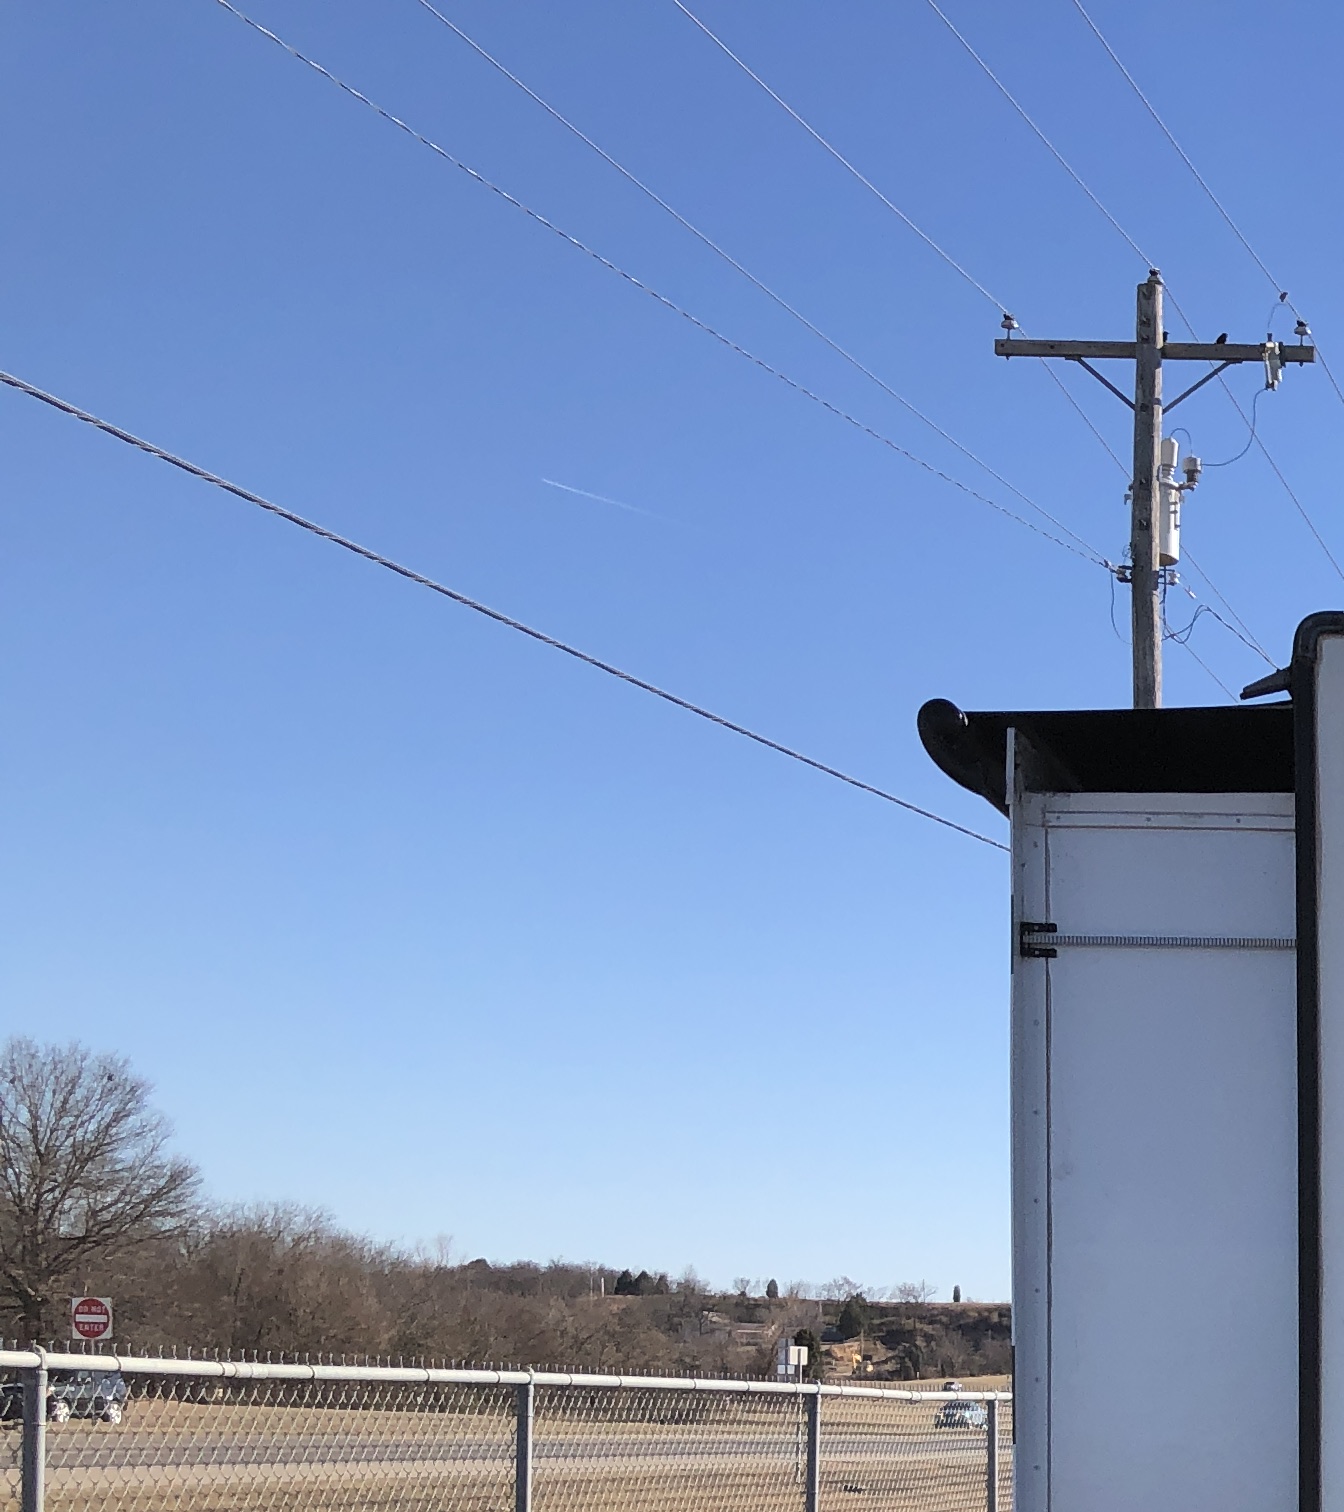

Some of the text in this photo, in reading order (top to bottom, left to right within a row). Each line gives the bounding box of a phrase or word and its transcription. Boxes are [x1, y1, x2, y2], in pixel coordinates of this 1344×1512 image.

[78, 1305, 106, 1313] DO NOT
[79, 1323, 104, 1332] ENTER
